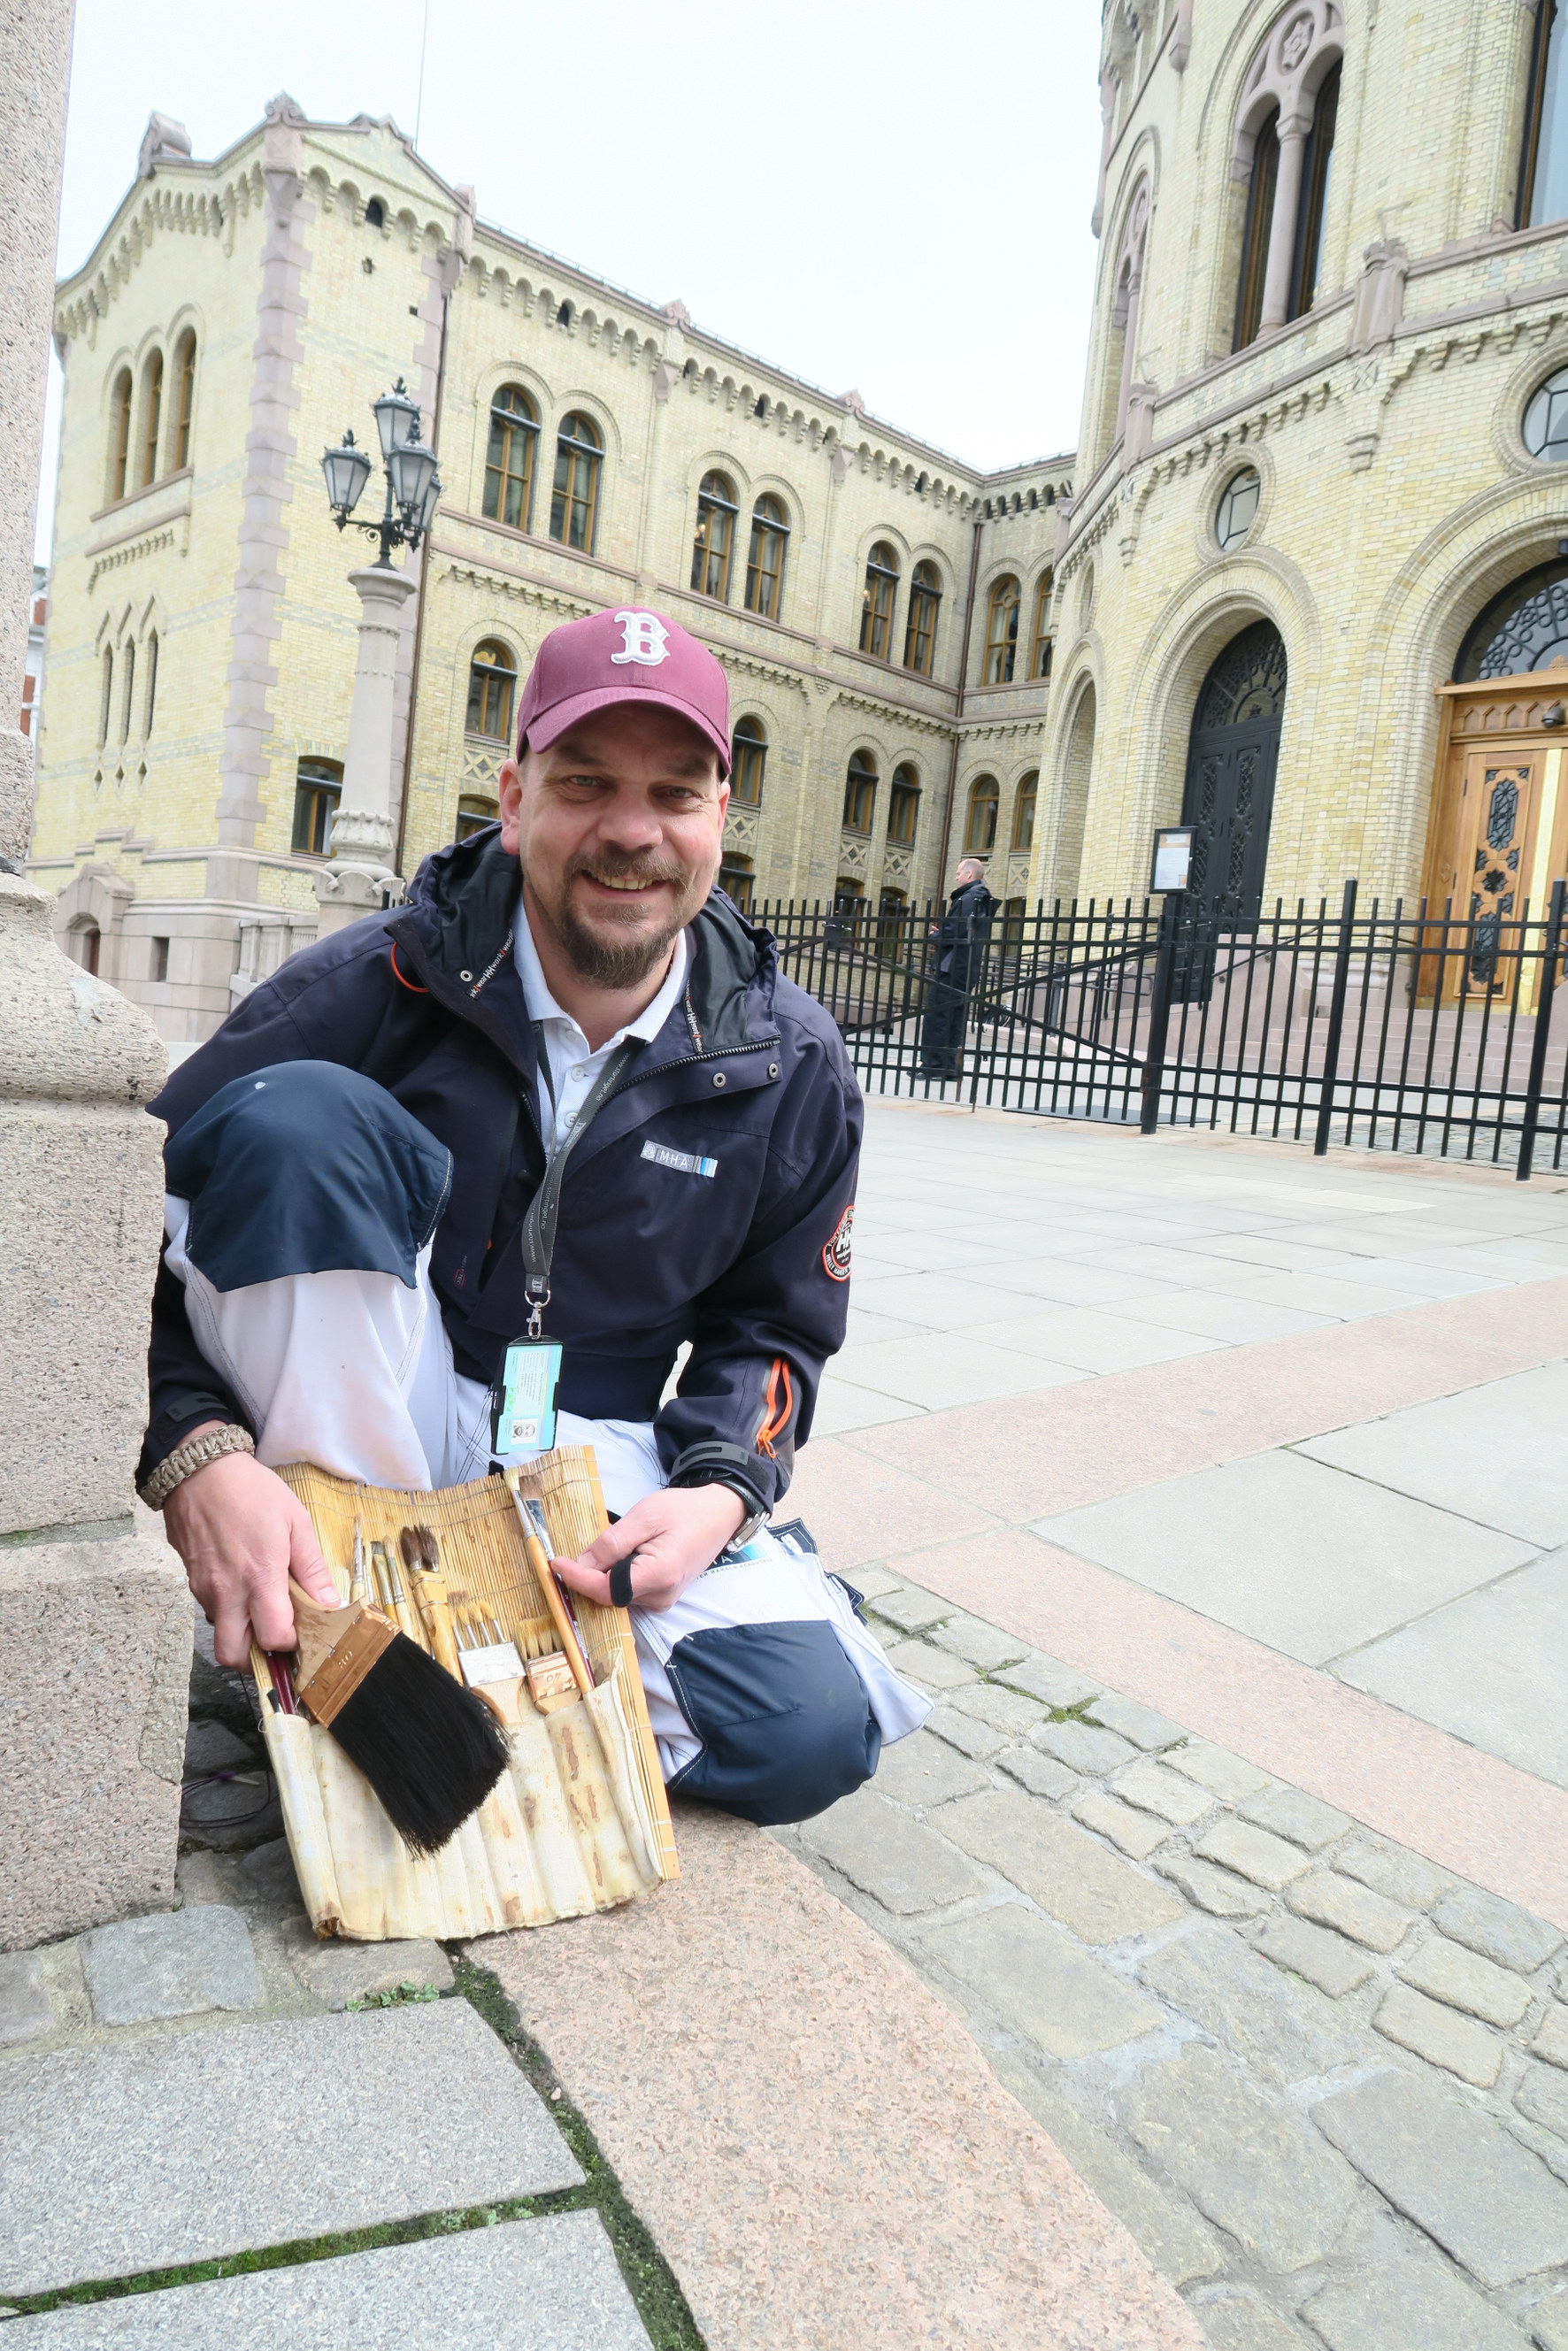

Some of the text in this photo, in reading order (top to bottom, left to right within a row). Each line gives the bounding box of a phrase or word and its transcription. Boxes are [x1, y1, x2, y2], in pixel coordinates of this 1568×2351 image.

[611, 611, 672, 666] B
[595, 1052, 629, 1102] www.stortinget.no
[659, 1150, 688, 1169] MHA
